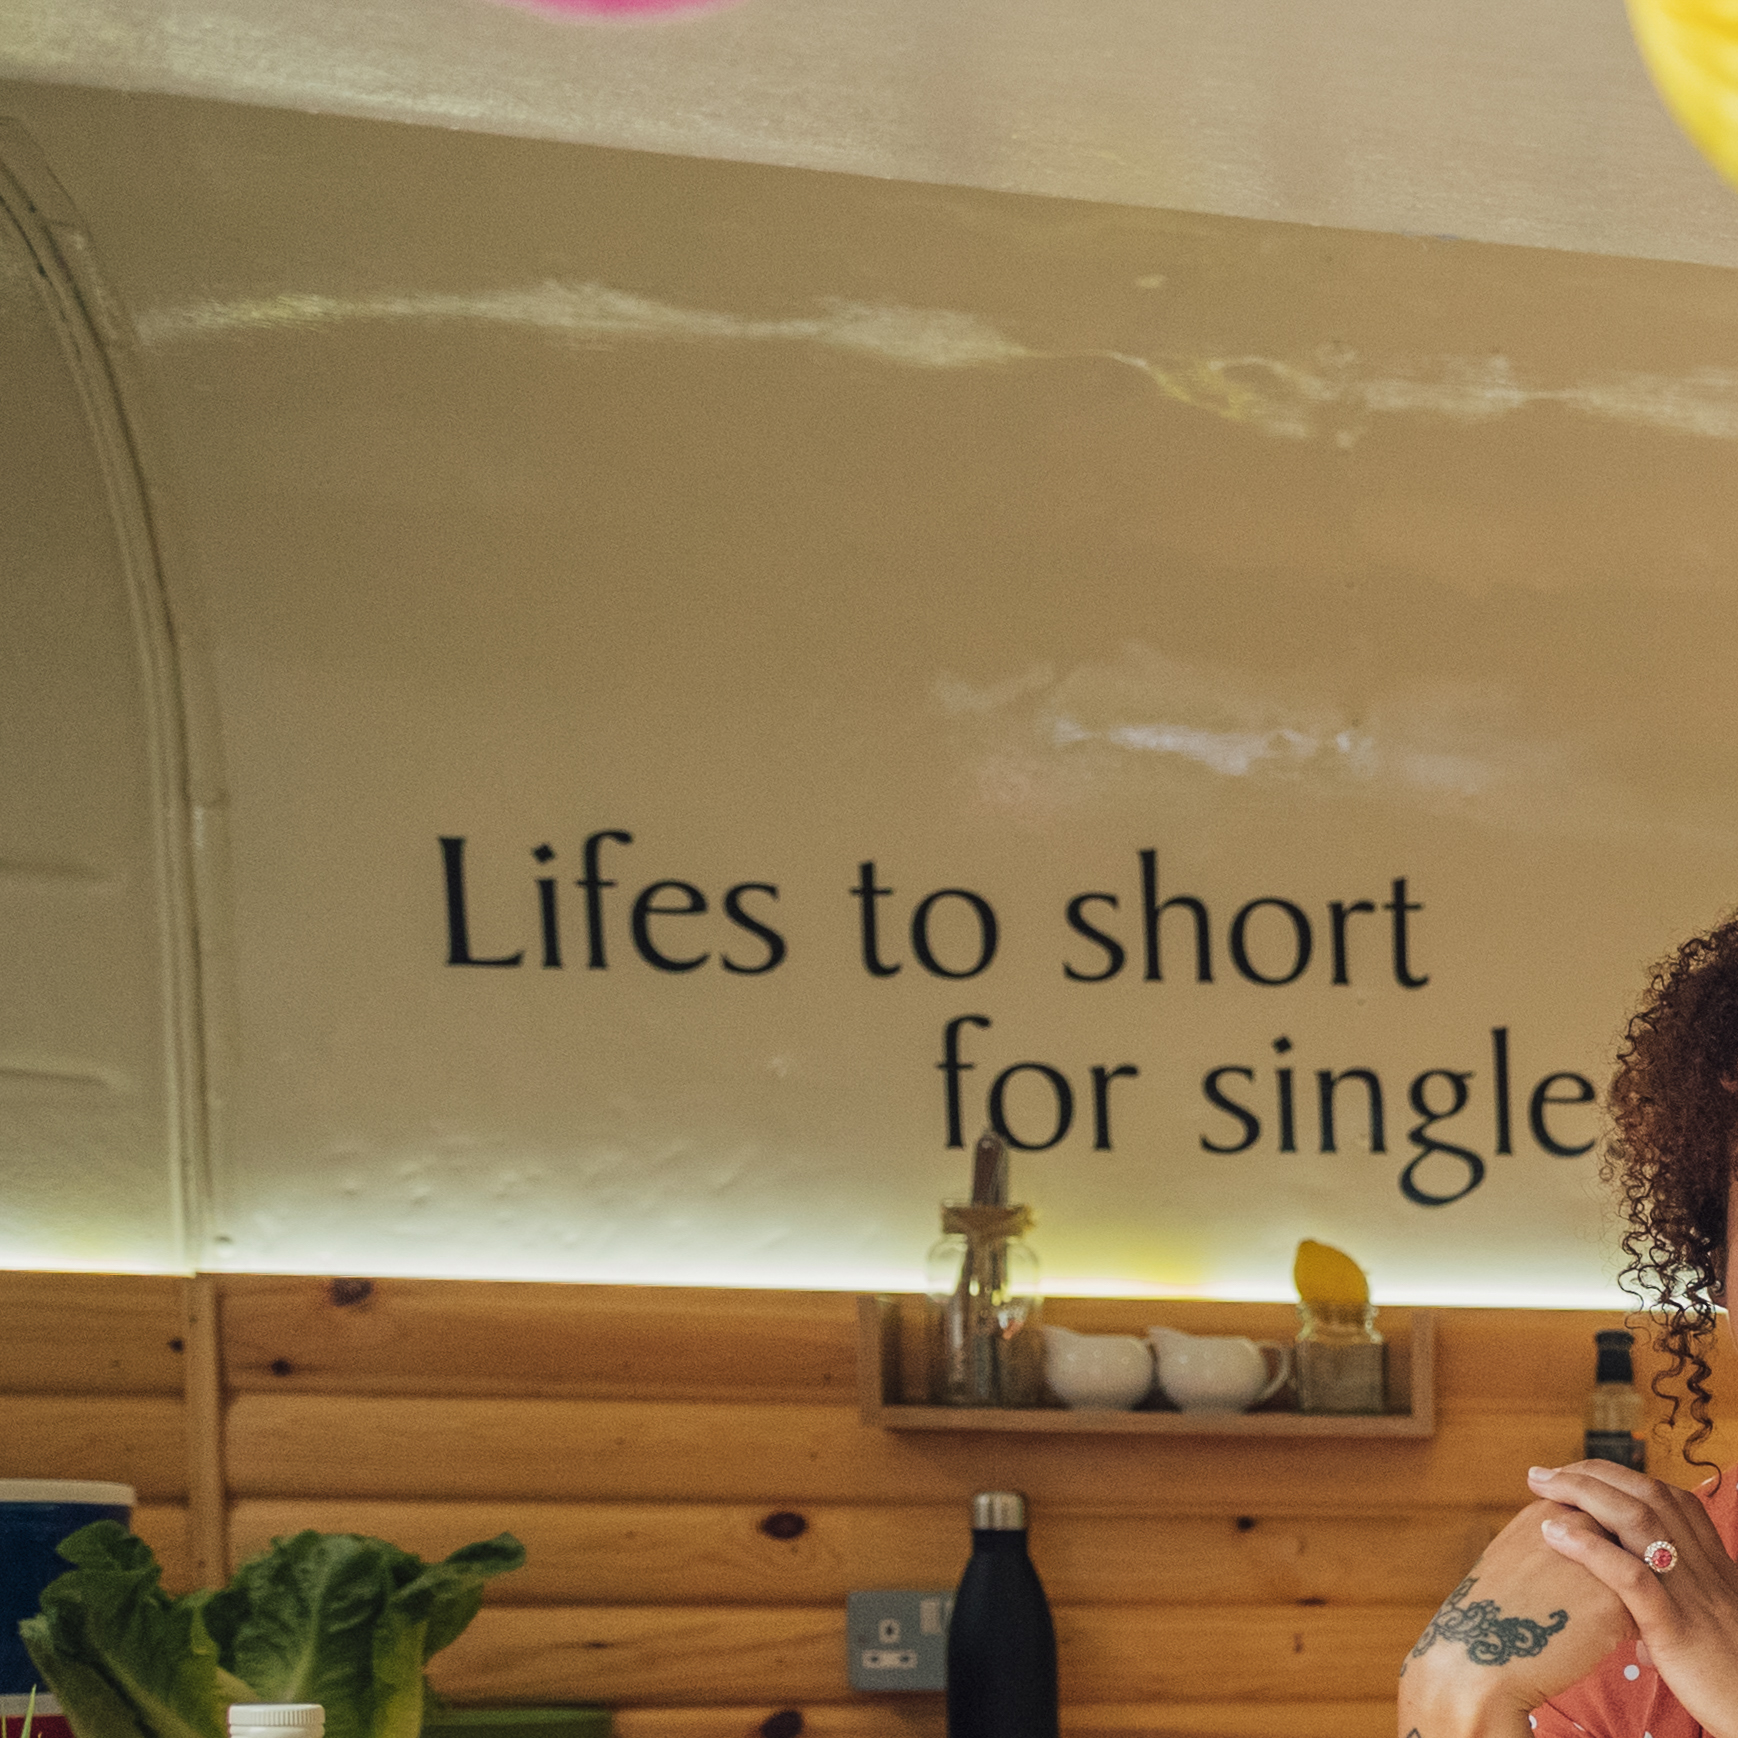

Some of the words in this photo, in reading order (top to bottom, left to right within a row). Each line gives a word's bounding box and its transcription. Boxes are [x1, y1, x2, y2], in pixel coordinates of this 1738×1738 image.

[437, 830, 788, 979] Lifes
[848, 859, 1001, 982] to
[1062, 846, 1431, 991] short
[934, 1012, 1140, 1155] for
[1200, 1024, 1627, 1209] single
